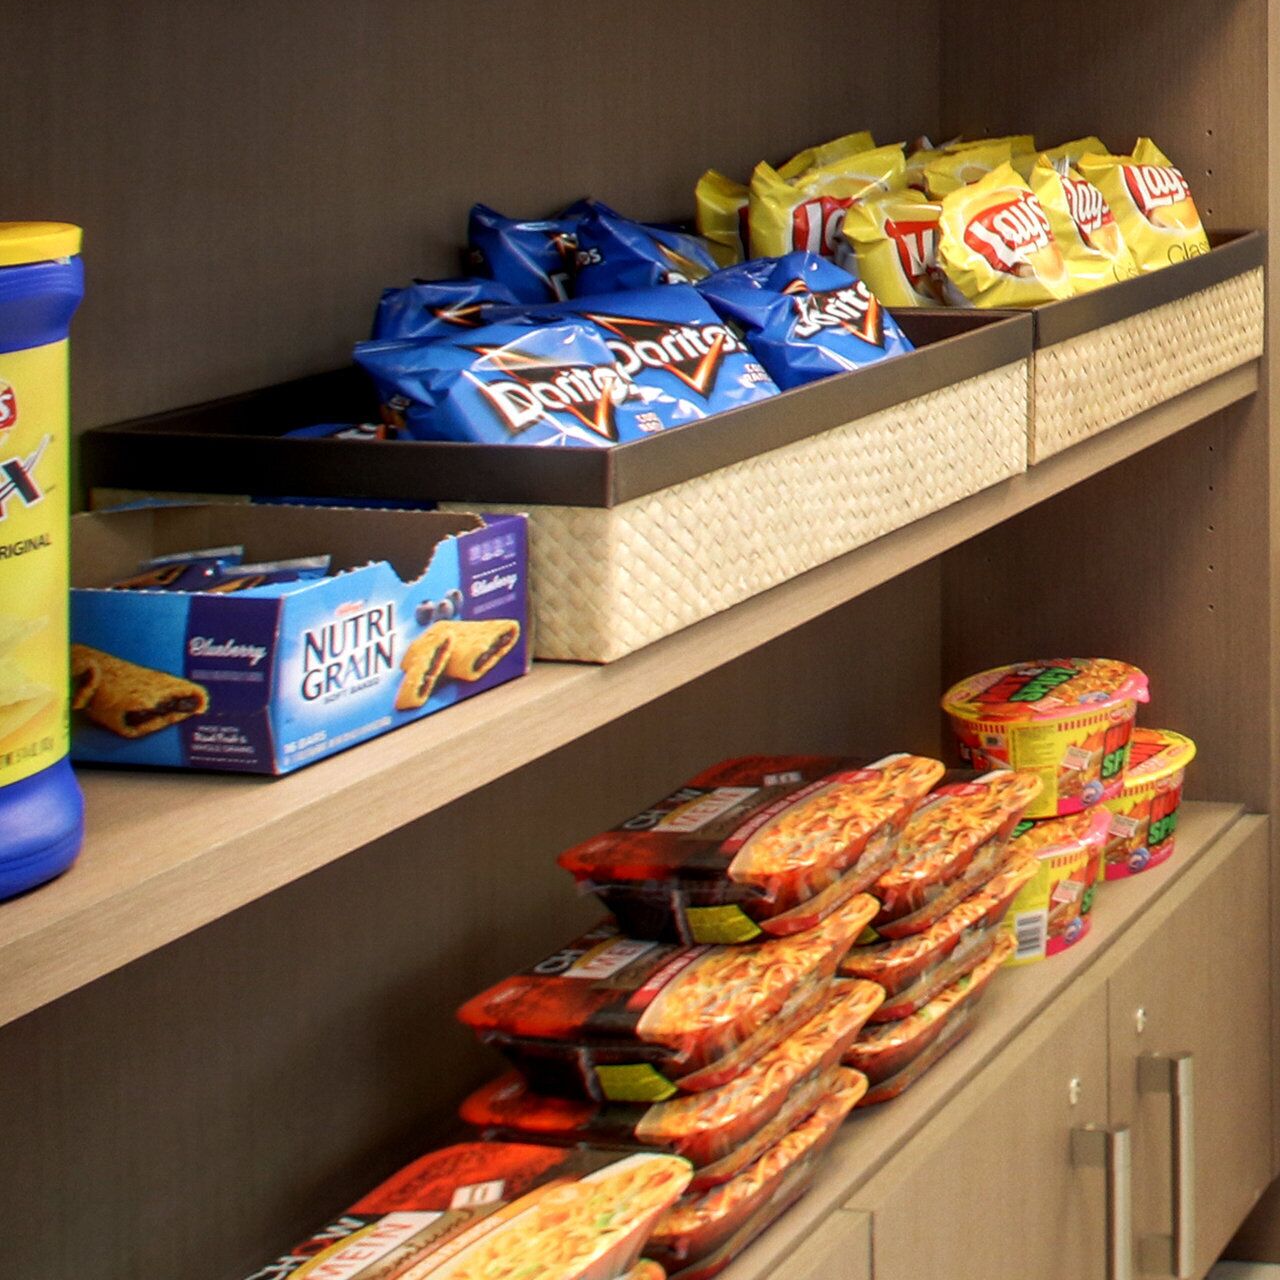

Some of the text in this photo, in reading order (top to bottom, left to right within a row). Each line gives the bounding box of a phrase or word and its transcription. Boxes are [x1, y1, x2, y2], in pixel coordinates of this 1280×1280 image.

[0, 532, 52, 560] RIGINAL
[189, 636, 268, 667] Blueberry
[304, 602, 395, 672] NUTRI
[301, 633, 396, 701] GRAIN
